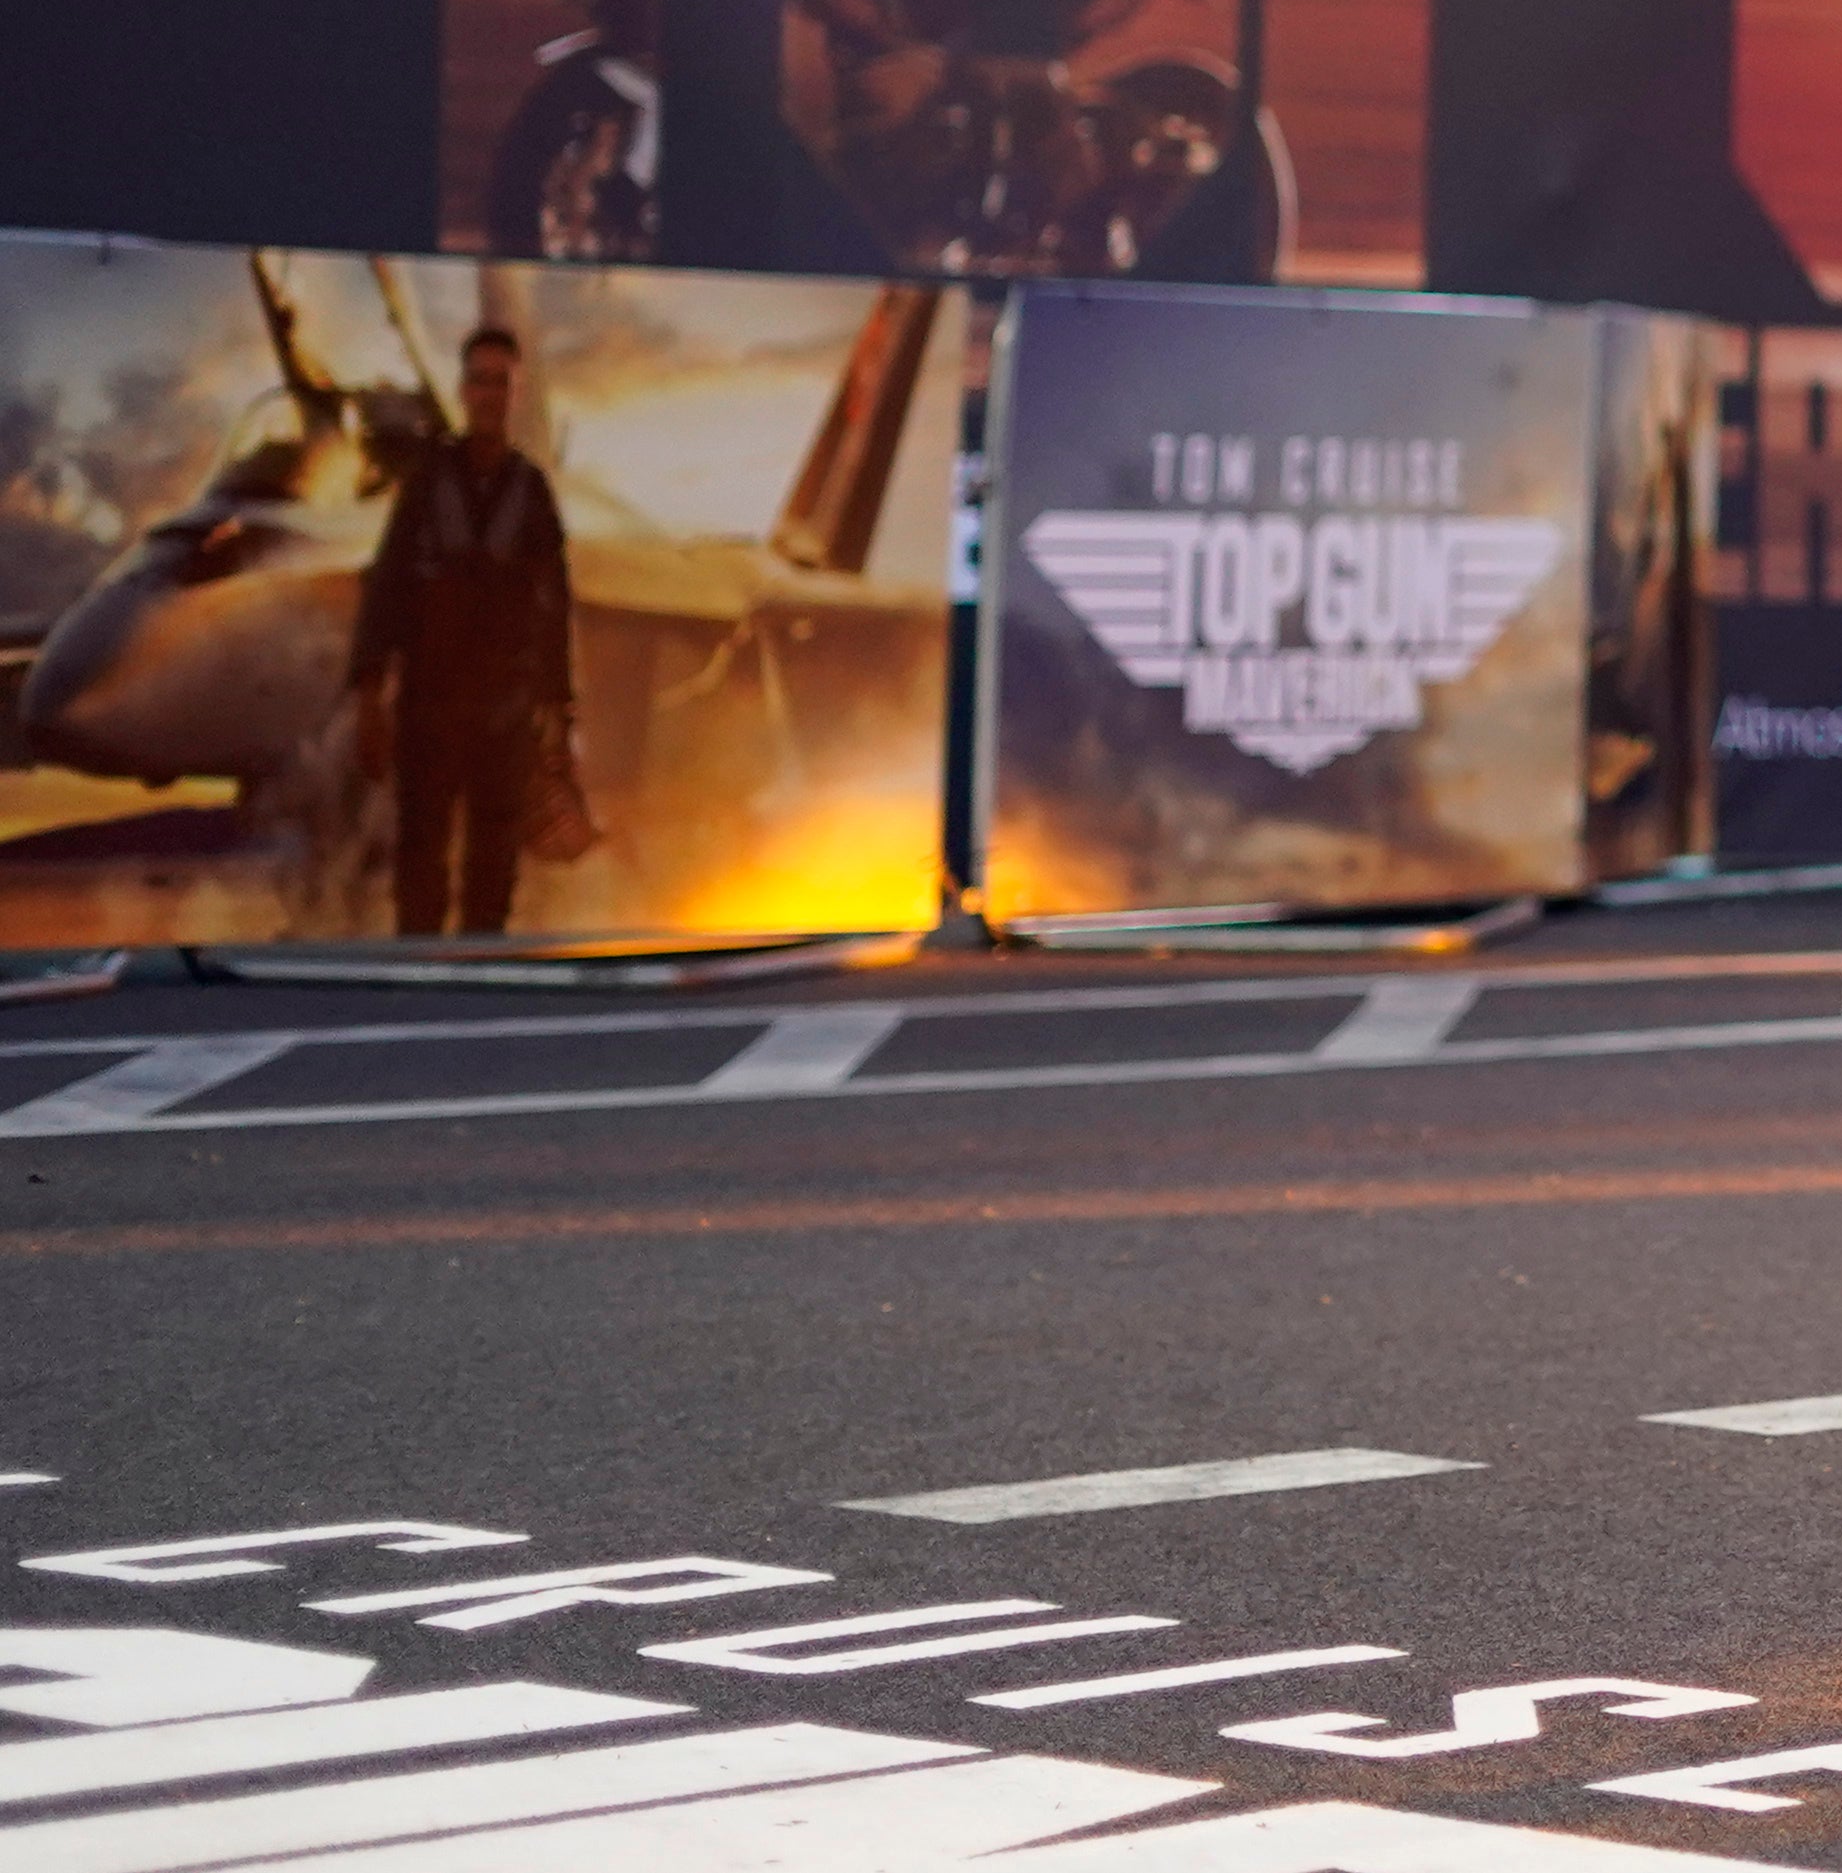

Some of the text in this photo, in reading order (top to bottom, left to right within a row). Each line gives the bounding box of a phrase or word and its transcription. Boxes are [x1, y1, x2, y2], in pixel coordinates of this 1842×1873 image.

[1150, 431, 1463, 508] TOM CRUISE
[1162, 511, 1452, 646] TOP GUN
